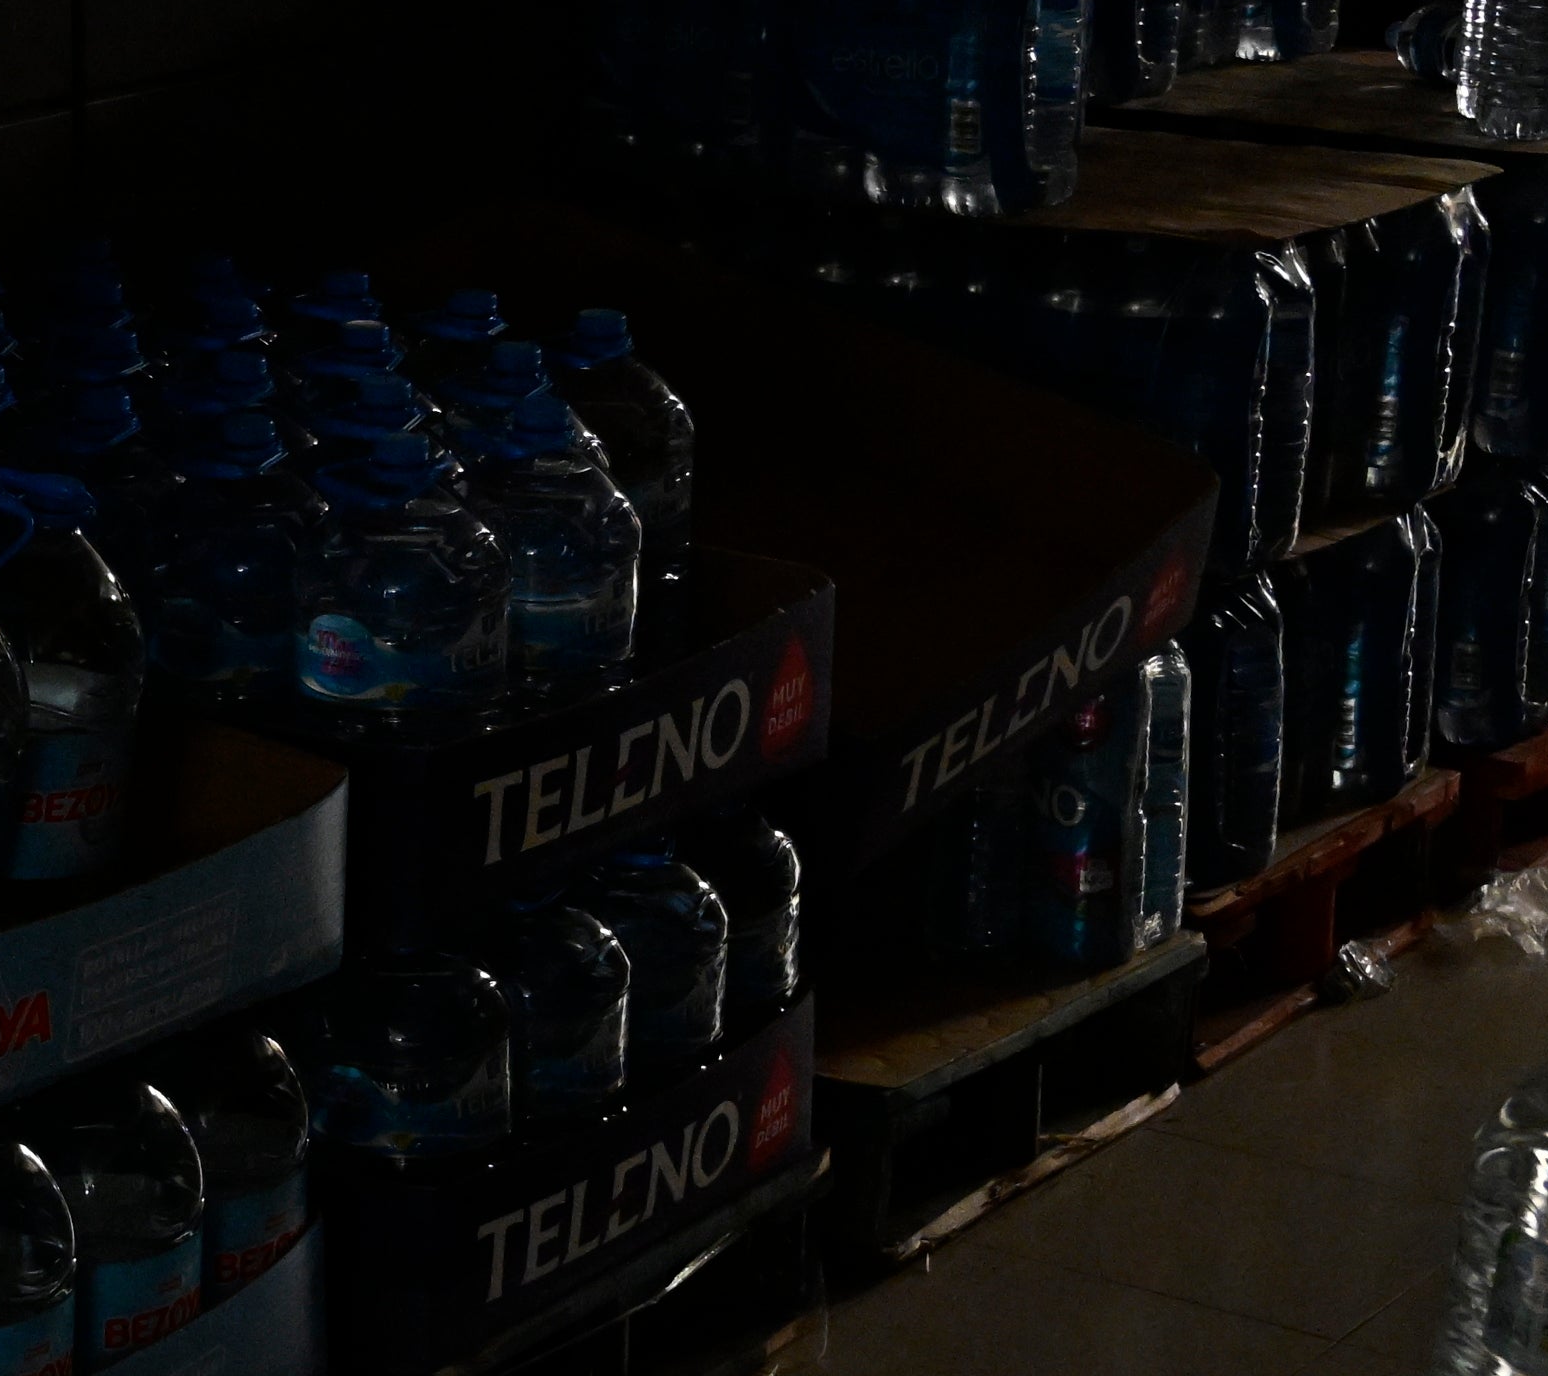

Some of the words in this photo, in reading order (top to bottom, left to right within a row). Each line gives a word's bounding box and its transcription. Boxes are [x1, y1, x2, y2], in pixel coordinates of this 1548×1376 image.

[473, 678, 752, 866] TELENO
[899, 593, 1135, 815] TELENO
[21, 784, 118, 826] BEZOY
[476, 1098, 741, 1305] TELENO
[103, 1286, 202, 1350] BEZOY
